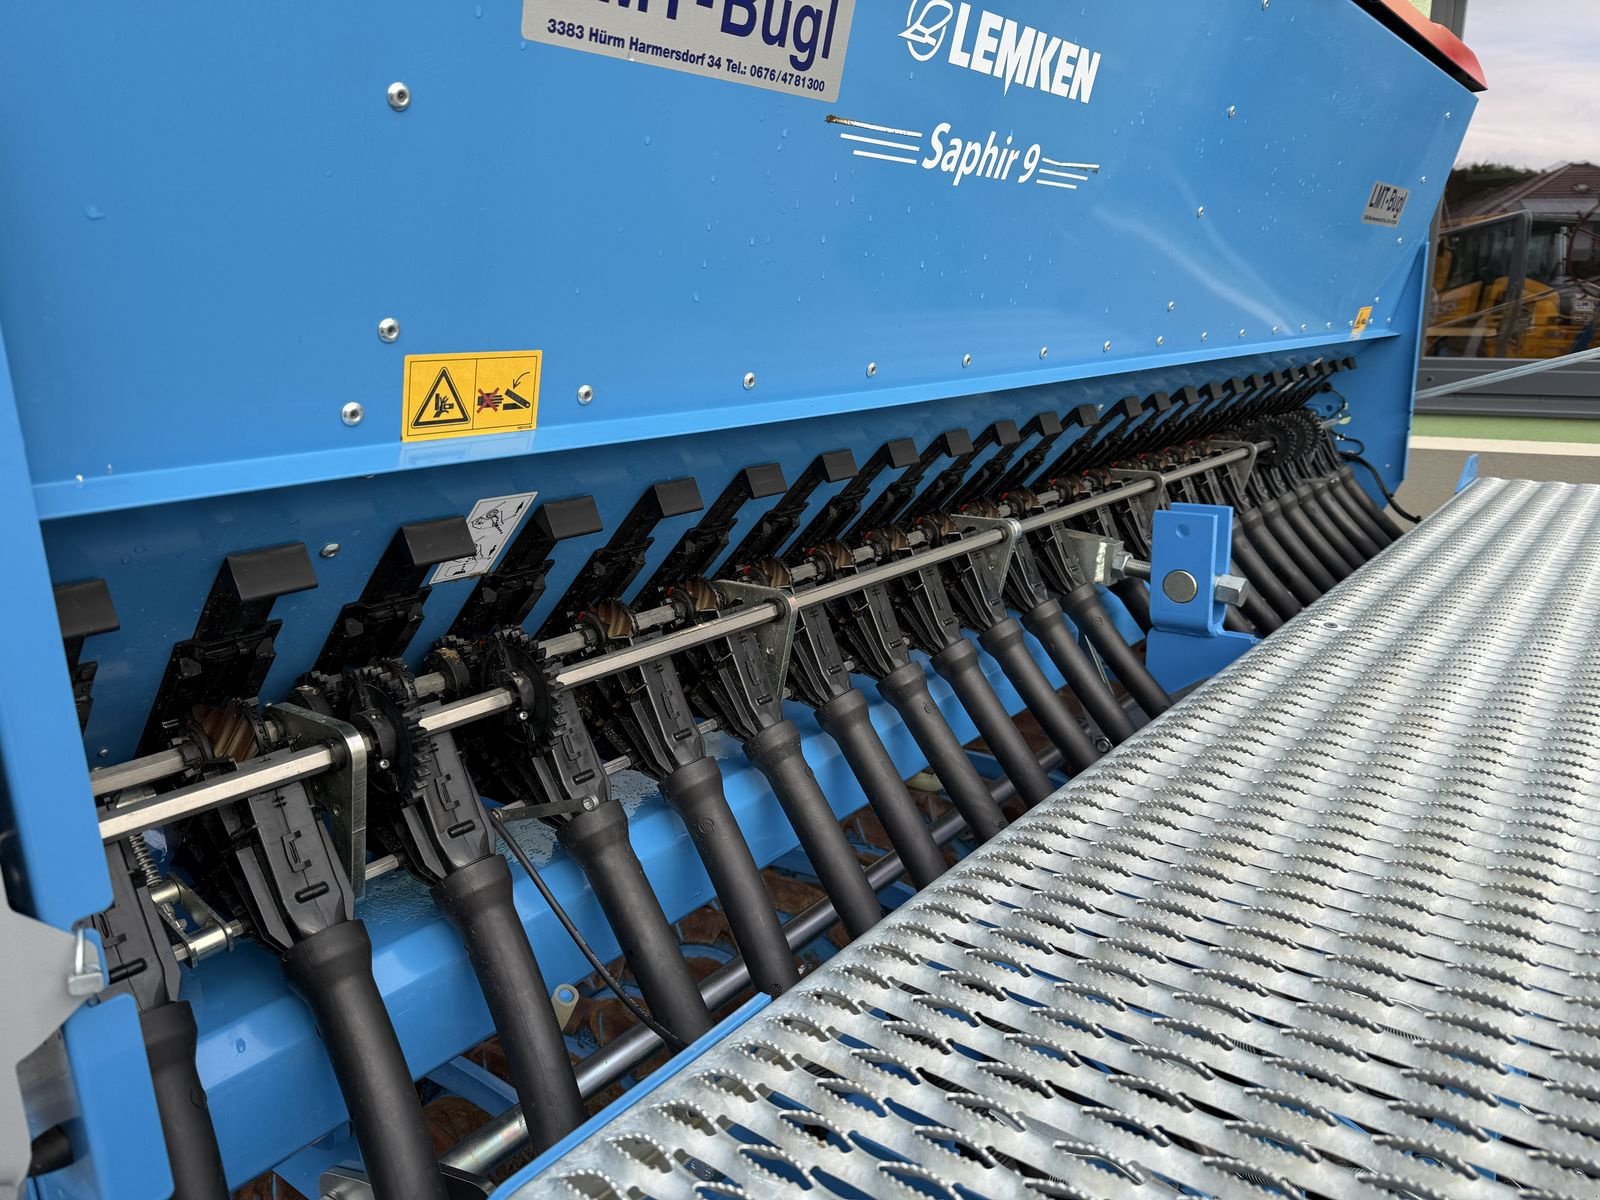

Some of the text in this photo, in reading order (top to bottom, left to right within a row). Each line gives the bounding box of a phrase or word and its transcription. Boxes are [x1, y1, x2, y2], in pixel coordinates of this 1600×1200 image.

[547, 18, 825, 92] 3383 Hürm Harmersdorf 34 Tel.: 0676/4781300
[599, 0, 838, 72] -Bugl
[948, 2, 1102, 104] LEMKEN
[922, 122, 1041, 187] Saphir 9
[1368, 183, 1408, 219] LMT-Bugl
